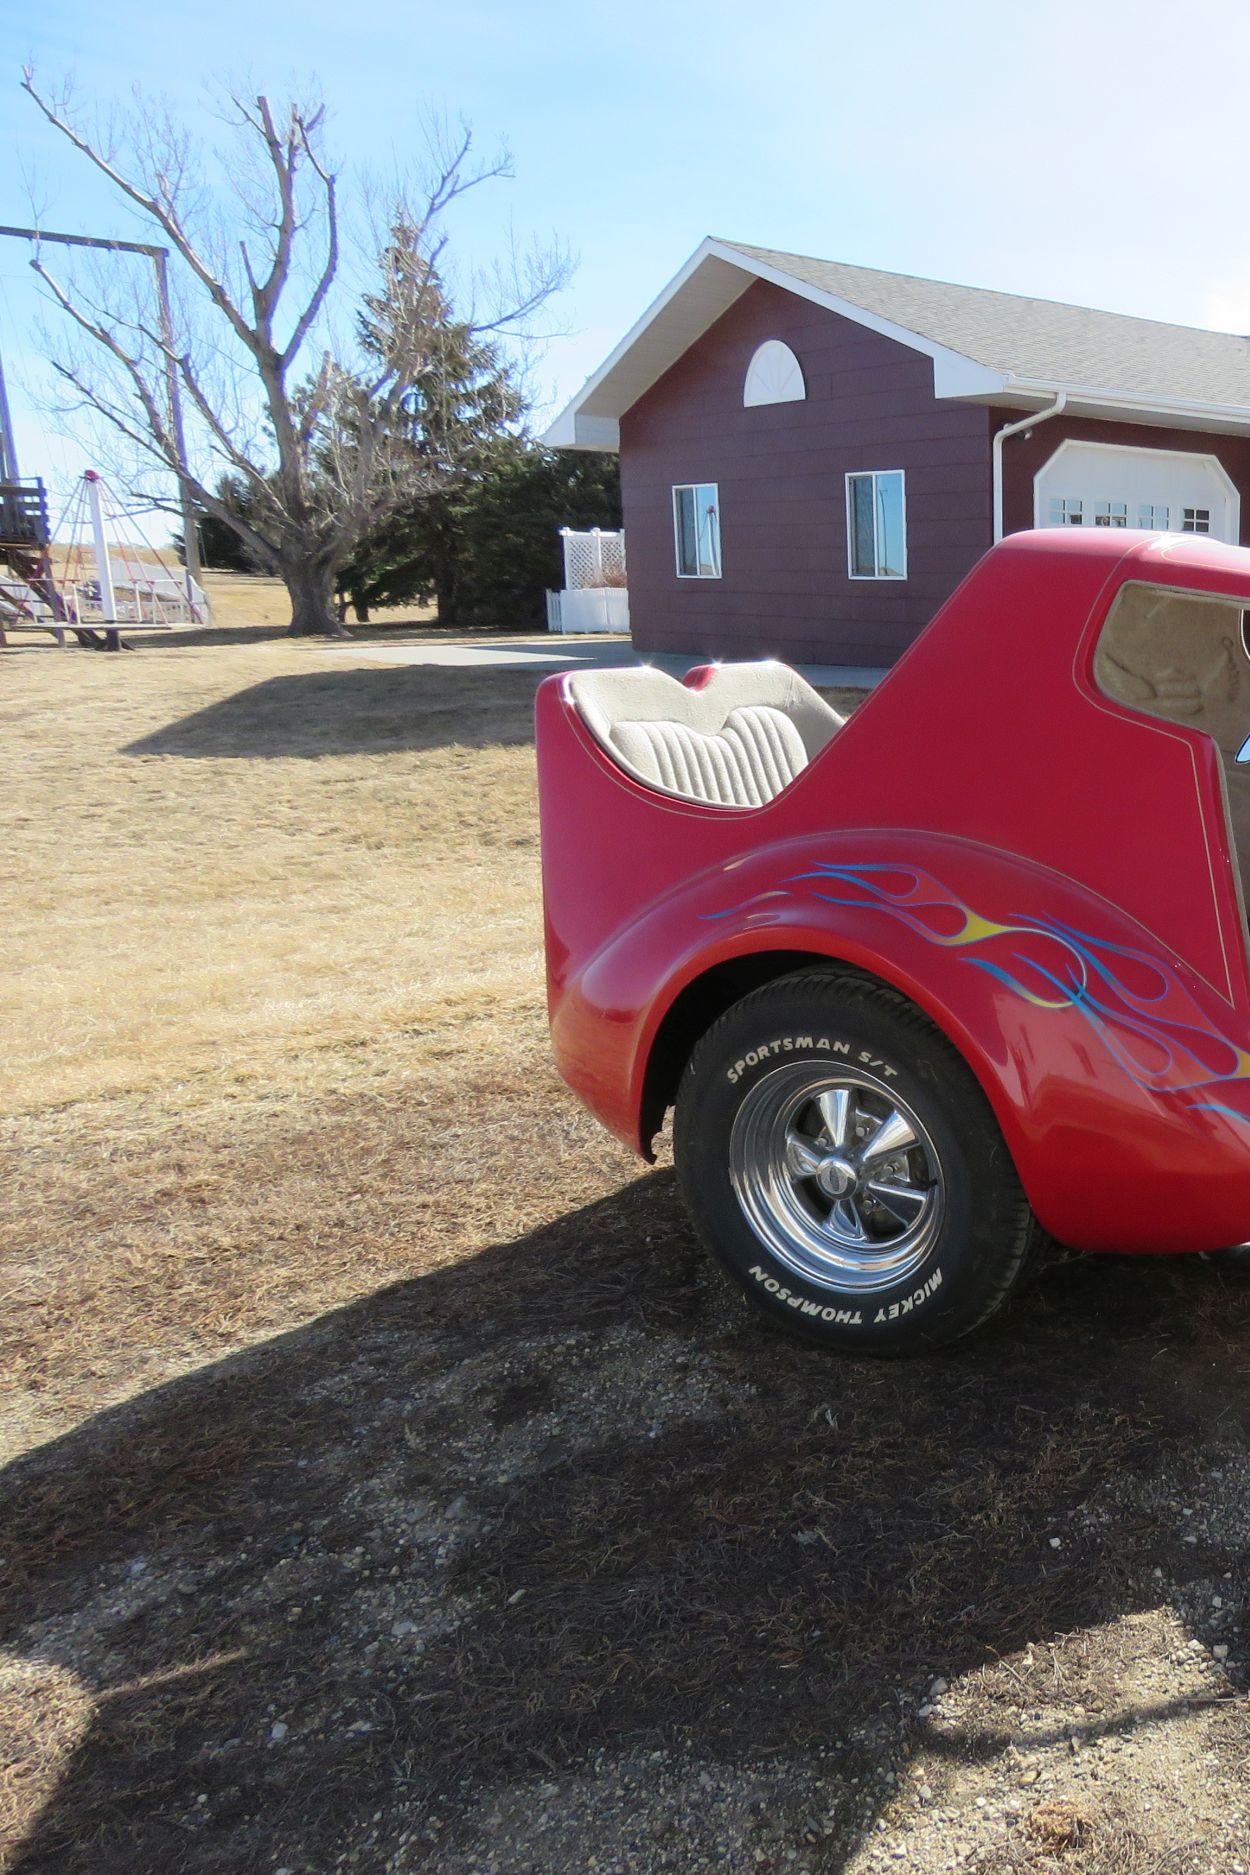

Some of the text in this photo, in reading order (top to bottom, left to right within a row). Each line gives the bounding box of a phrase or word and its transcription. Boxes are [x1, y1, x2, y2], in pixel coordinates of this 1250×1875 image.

[726, 1037, 898, 1084] SPORTSMAN S/T
[748, 1264, 944, 1325] MICKEY THOMPSON
